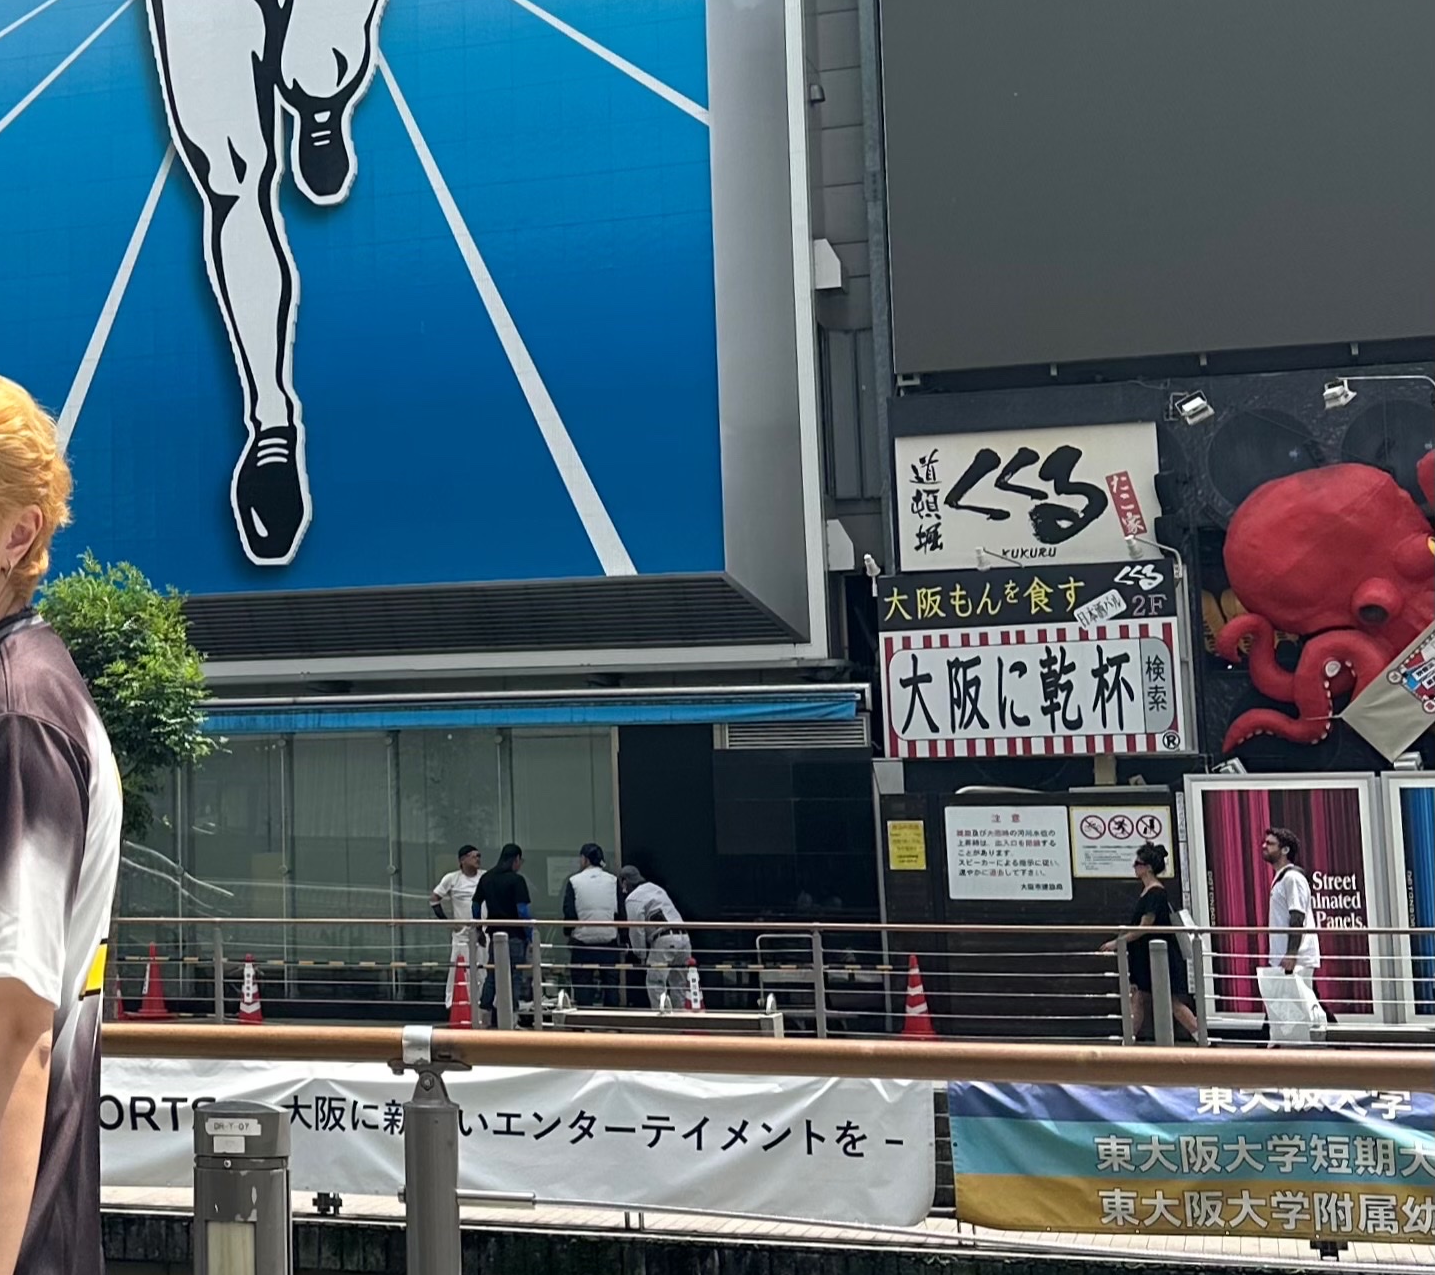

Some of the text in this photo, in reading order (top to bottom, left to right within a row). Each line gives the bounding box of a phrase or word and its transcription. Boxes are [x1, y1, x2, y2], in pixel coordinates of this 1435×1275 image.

[910, 445, 1108, 555] 道頓堀 くくる
[1002, 547, 1057, 559] KUKURU
[883, 576, 1085, 622] 大阪もんを食す
[1114, 564, 1164, 590] くくる
[1077, 591, 1122, 628] 日本酒バル
[1132, 594, 1167, 617] 2F
[899, 644, 1134, 735] 大阪に乾杯
[1145, 655, 1167, 712] 検索
[1312, 871, 1356, 890] Street
[1094, 1134, 1435, 1178] 東大阪大学短期大
[1097, 1188, 1435, 1235] 東大阪大学附属幼
